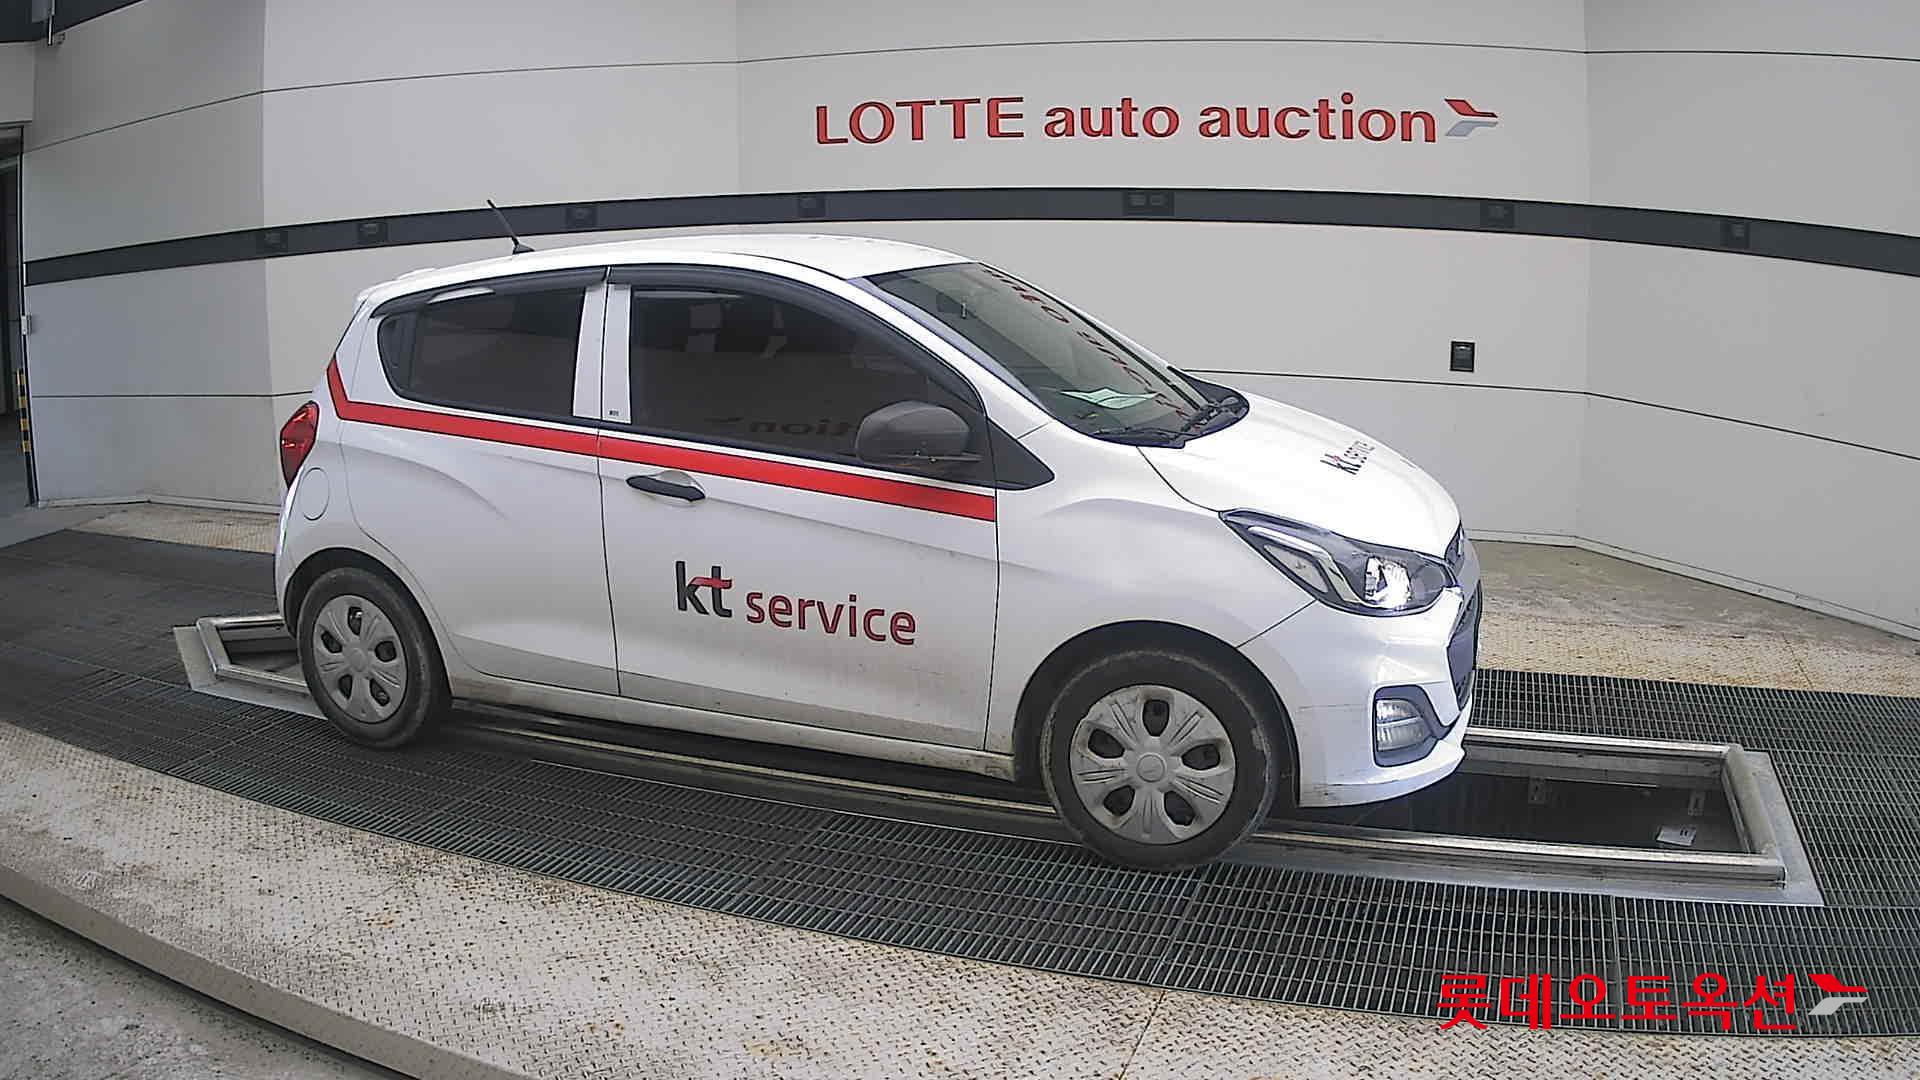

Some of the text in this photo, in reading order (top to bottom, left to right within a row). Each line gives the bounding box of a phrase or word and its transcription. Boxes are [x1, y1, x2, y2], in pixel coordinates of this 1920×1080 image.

[816, 93, 1437, 144] LOTTE auto auction
[675, 560, 917, 645] kt service
